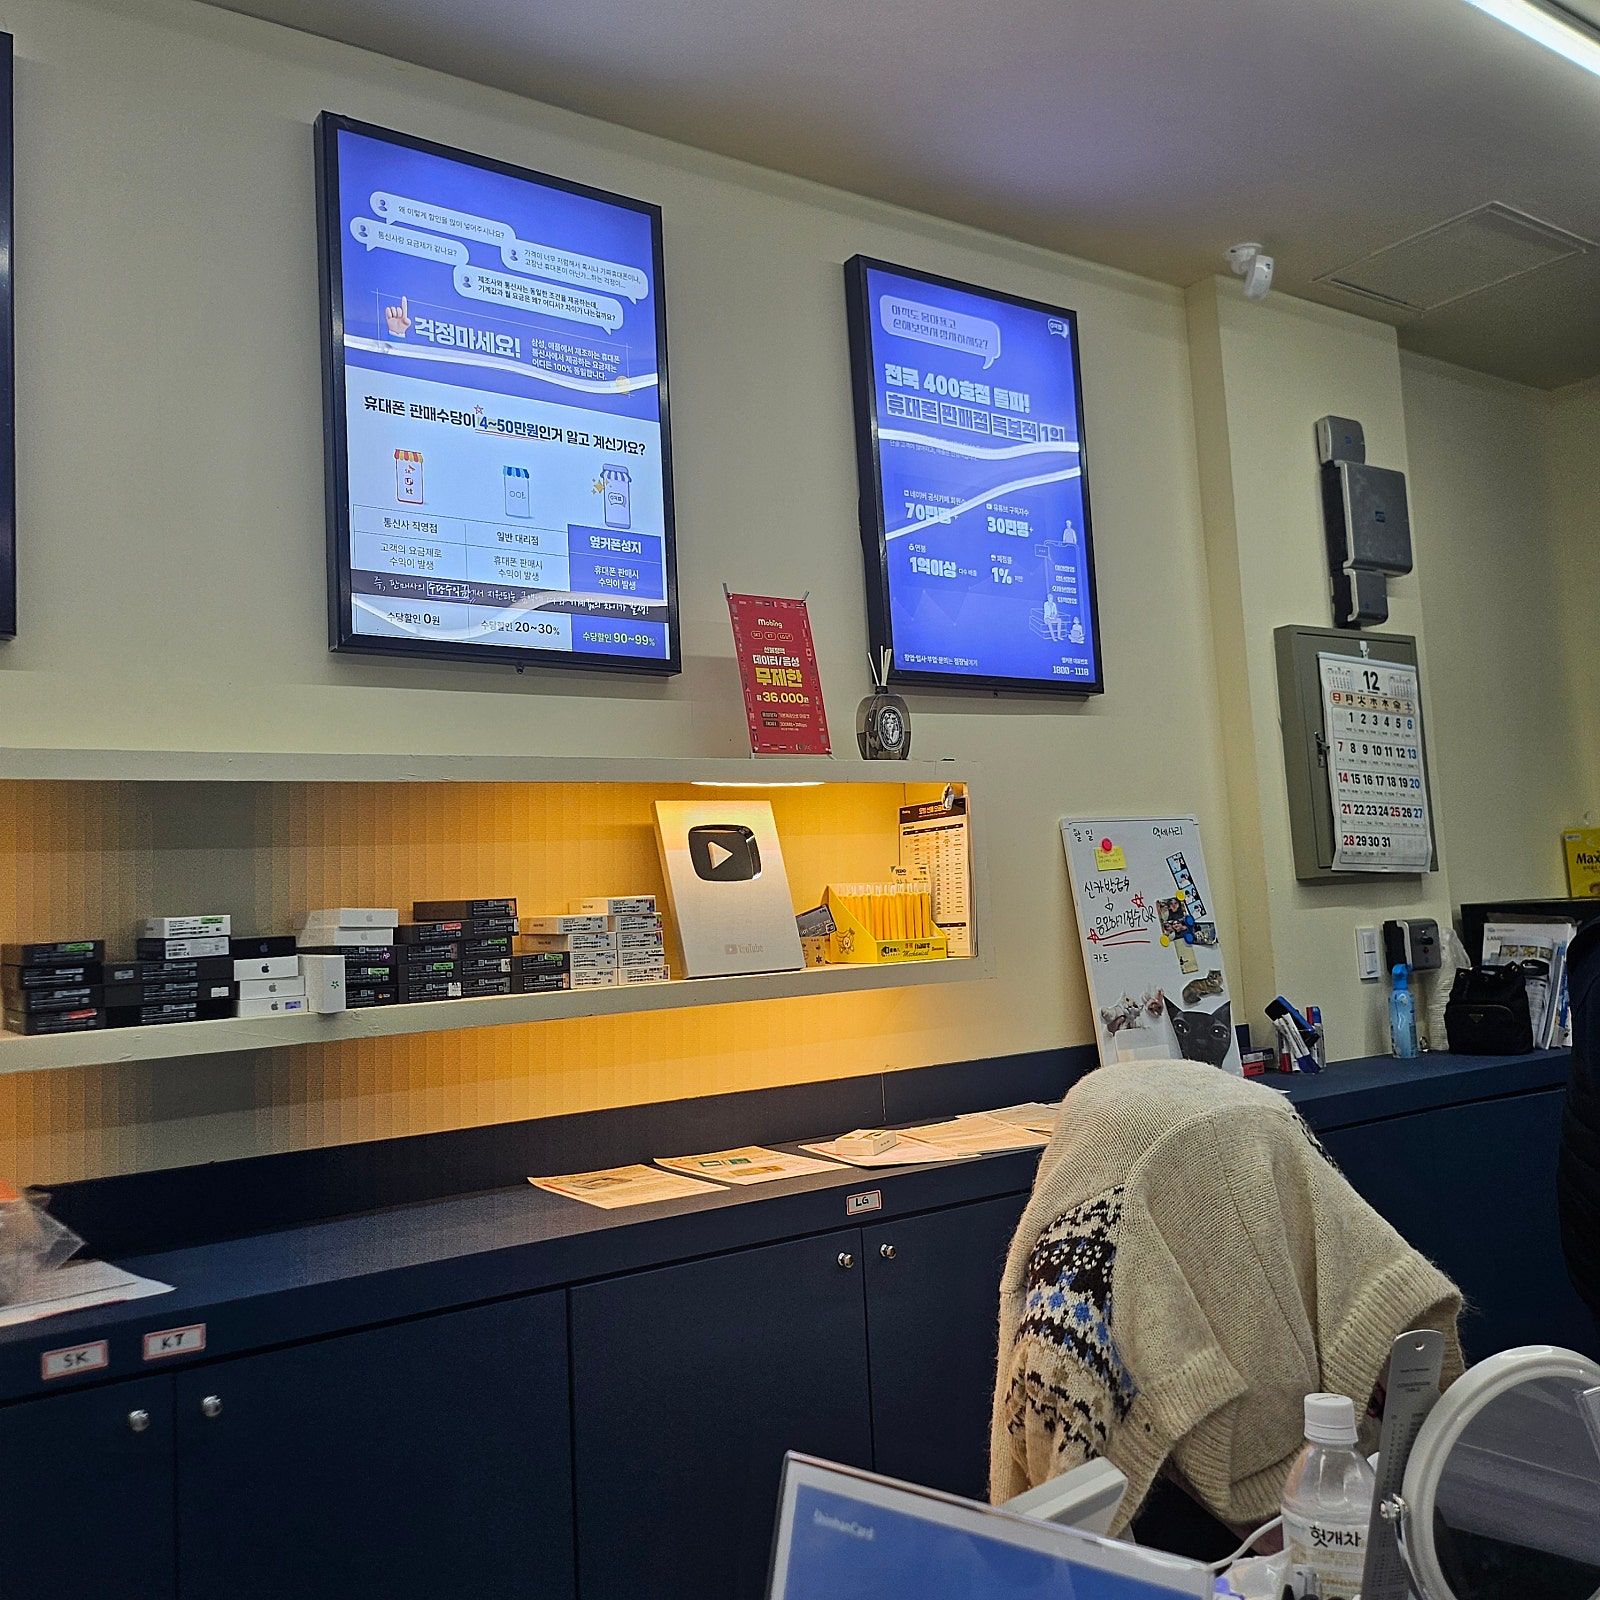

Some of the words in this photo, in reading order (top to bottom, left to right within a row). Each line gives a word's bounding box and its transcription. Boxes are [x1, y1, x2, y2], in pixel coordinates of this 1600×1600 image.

[408, 208, 427, 219] 이렇게
[478, 275, 503, 288] 제조사와
[505, 281, 528, 294] 통신사는
[530, 286, 547, 298] 동일한
[549, 290, 566, 302] 조건을
[478, 284, 503, 296] 기계값과
[513, 292, 530, 303] 요금은
[566, 304, 583, 315] 차이가
[892, 305, 919, 319] 아직도
[414, 317, 521, 358] 걱정마세요!
[532, 338, 546, 349] 삼성,
[575, 347, 600, 360] 제조하는
[601, 353, 620, 363] 휴대폰
[532, 359, 552, 370] 어디든
[553, 362, 572, 374] 100%
[574, 367, 607, 380] 동일합니다.
[565, 354, 590, 367] 제공하는
[593, 360, 617, 373] 요금제는
[885, 363, 919, 390] 전국
[924, 373, 990, 406] 400호점
[994, 388, 1030, 413] 돌파!
[886, 391, 938, 424] 휴대폰
[940, 402, 990, 434] 판매점
[991, 413, 1037, 443] 독보적
[364, 395, 405, 417] 휴대폰
[410, 403, 476, 428] 판매수당이
[479, 416, 562, 442] 4~50만원인거
[567, 430, 589, 446] 알고
[593, 435, 646, 456] 계신가요?
[928, 493, 949, 503] 공식카페
[1009, 506, 1029, 516] 구독자수
[384, 518, 409, 530] 통신사
[412, 521, 438, 533] 직영점
[497, 532, 513, 543] 일반
[515, 534, 538, 546] 대리점
[589, 535, 641, 554] 옆커폰성지
[381, 543, 405, 554] 고객의
[409, 546, 442, 558] 요금제로
[390, 556, 414, 568] 수익이
[418, 560, 434, 570] 발생
[494, 556, 517, 567] 휴대폰
[520, 559, 542, 570] 판매시
[910, 557, 956, 578] 1억이상
[499, 568, 522, 580] 수익이
[524, 571, 539, 582] 발생
[594, 565, 616, 577] 휴대폰
[618, 568, 638, 579] 판매시
[992, 567, 1012, 584] 1%
[374, 576, 386, 591] 즉,
[599, 578, 620, 588] 수익이
[622, 580, 636, 590] 발생
[387, 612, 421, 624] 수당할인
[424, 613, 440, 625] 0원
[515, 622, 560, 635] 20~30%
[583, 632, 611, 642] 수당할인
[613, 632, 655, 646] 90~99%
[755, 667, 803, 687] 무제한
[1363, 671, 1380, 691] 12
[1333, 693, 1341, 701] 日
[1346, 694, 1353, 702] 月
[1357, 695, 1366, 705] 火
[1404, 702, 1412, 711] 土
[1349, 712, 1353, 722] 1
[1360, 714, 1366, 725] 2
[1372, 715, 1378, 726] 3
[1384, 717, 1389, 727] 4
[1396, 718, 1401, 728] 5
[1407, 719, 1412, 730] 6
[1338, 741, 1343, 752] 7
[1350, 743, 1356, 754] 8
[1362, 744, 1368, 755] 9
[1372, 745, 1382, 756] 10
[1384, 746, 1393, 757] 11
[1396, 747, 1405, 758] 12
[1408, 748, 1417, 759] 13
[1338, 773, 1348, 783] 14
[1351, 774, 1360, 785] 15
[1363, 774, 1373, 786] 16
[1375, 776, 1384, 786] 17
[1387, 776, 1396, 787] 18
[1399, 777, 1408, 788] 19
[1410, 778, 1420, 789] 20
[1342, 804, 1351, 815] 21
[1354, 804, 1365, 815] 22
[1366, 805, 1377, 816] 23
[1379, 806, 1389, 817] 24
[1390, 806, 1401, 817] 25
[1402, 807, 1412, 818] 26
[1414, 808, 1423, 819] 27
[1086, 829, 1093, 841] 일
[1343, 835, 1354, 846] 28
[1356, 835, 1367, 847] 29
[1368, 836, 1380, 847] 30
[1382, 837, 1391, 847] 31
[1094, 954, 1109, 962] 카드
[855, 1196, 869, 1207] LG
[161, 1333, 185, 1350] KT
[63, 1350, 89, 1368] SK
[1309, 1525, 1361, 1548] 헛개차
